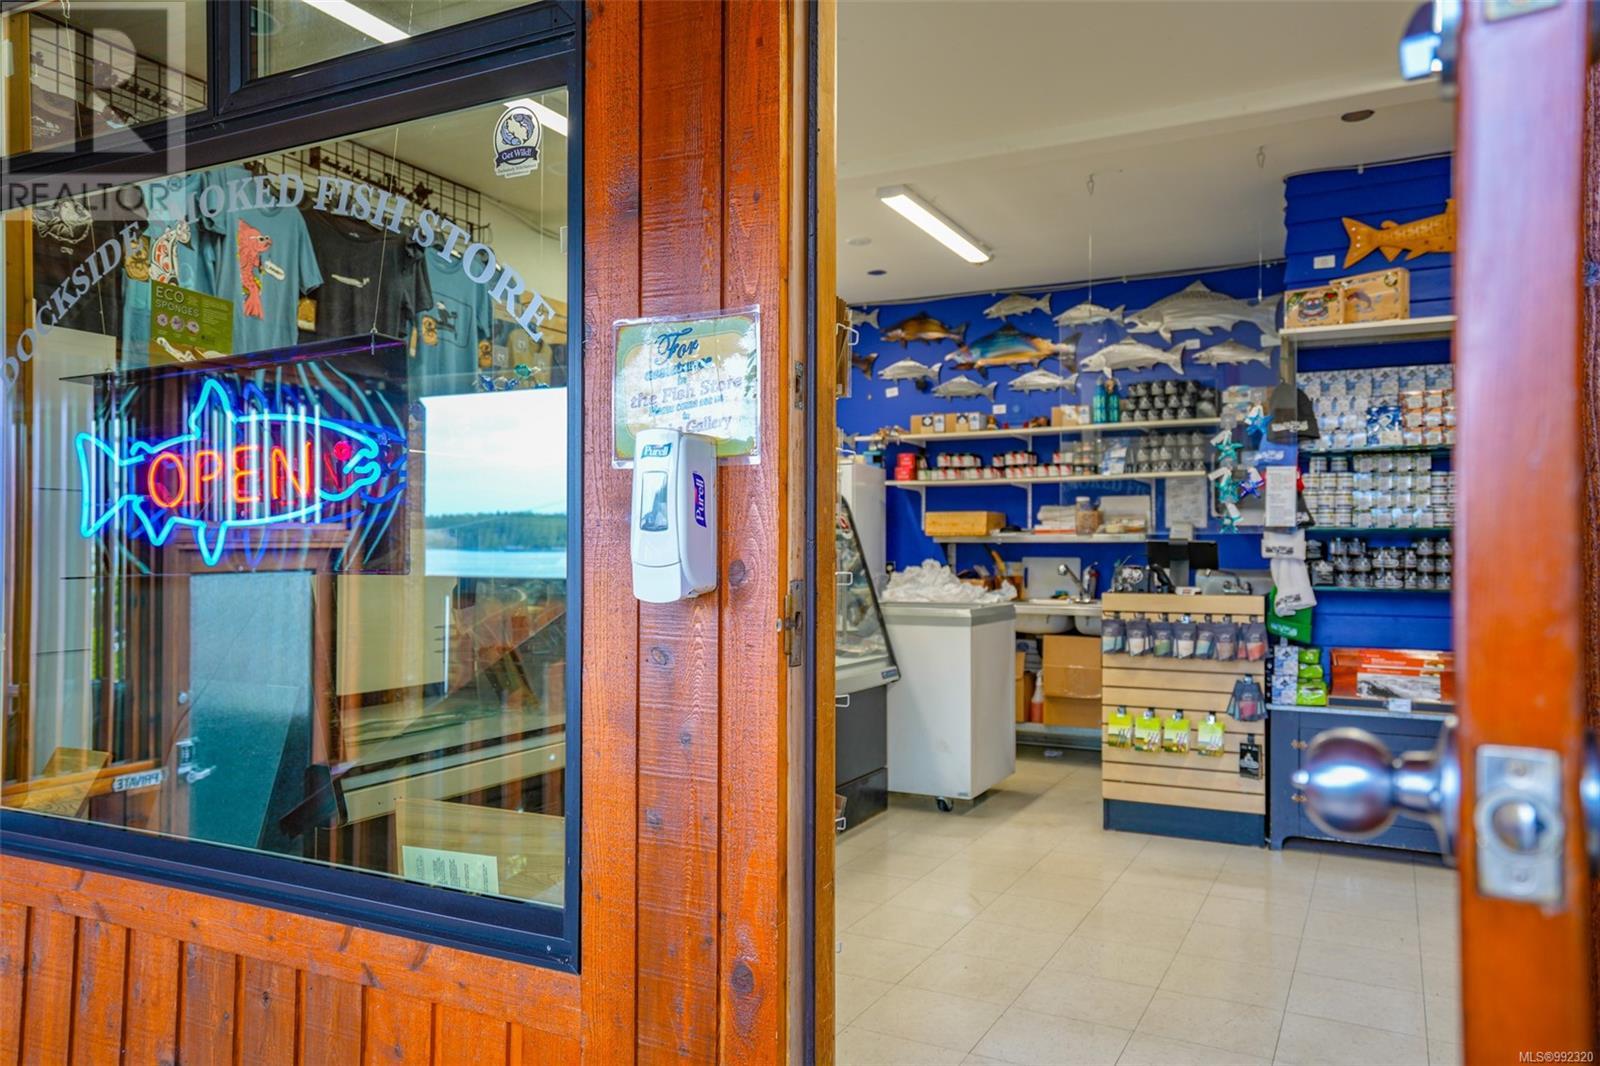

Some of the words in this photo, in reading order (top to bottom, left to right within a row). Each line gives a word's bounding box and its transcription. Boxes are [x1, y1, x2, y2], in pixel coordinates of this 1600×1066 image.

[501, 150, 513, 160] Get
[0, 221, 145, 388] DOCKSIDE
[160, 173, 304, 232] OKED
[313, 175, 410, 234] FISH
[413, 209, 556, 342] STORE
[156, 286, 184, 303] ECO
[156, 299, 199, 317] SPONGES
[655, 327, 699, 365] For
[662, 383, 696, 404] Fish
[700, 375, 742, 394] Store
[149, 441, 313, 508] OPEN
